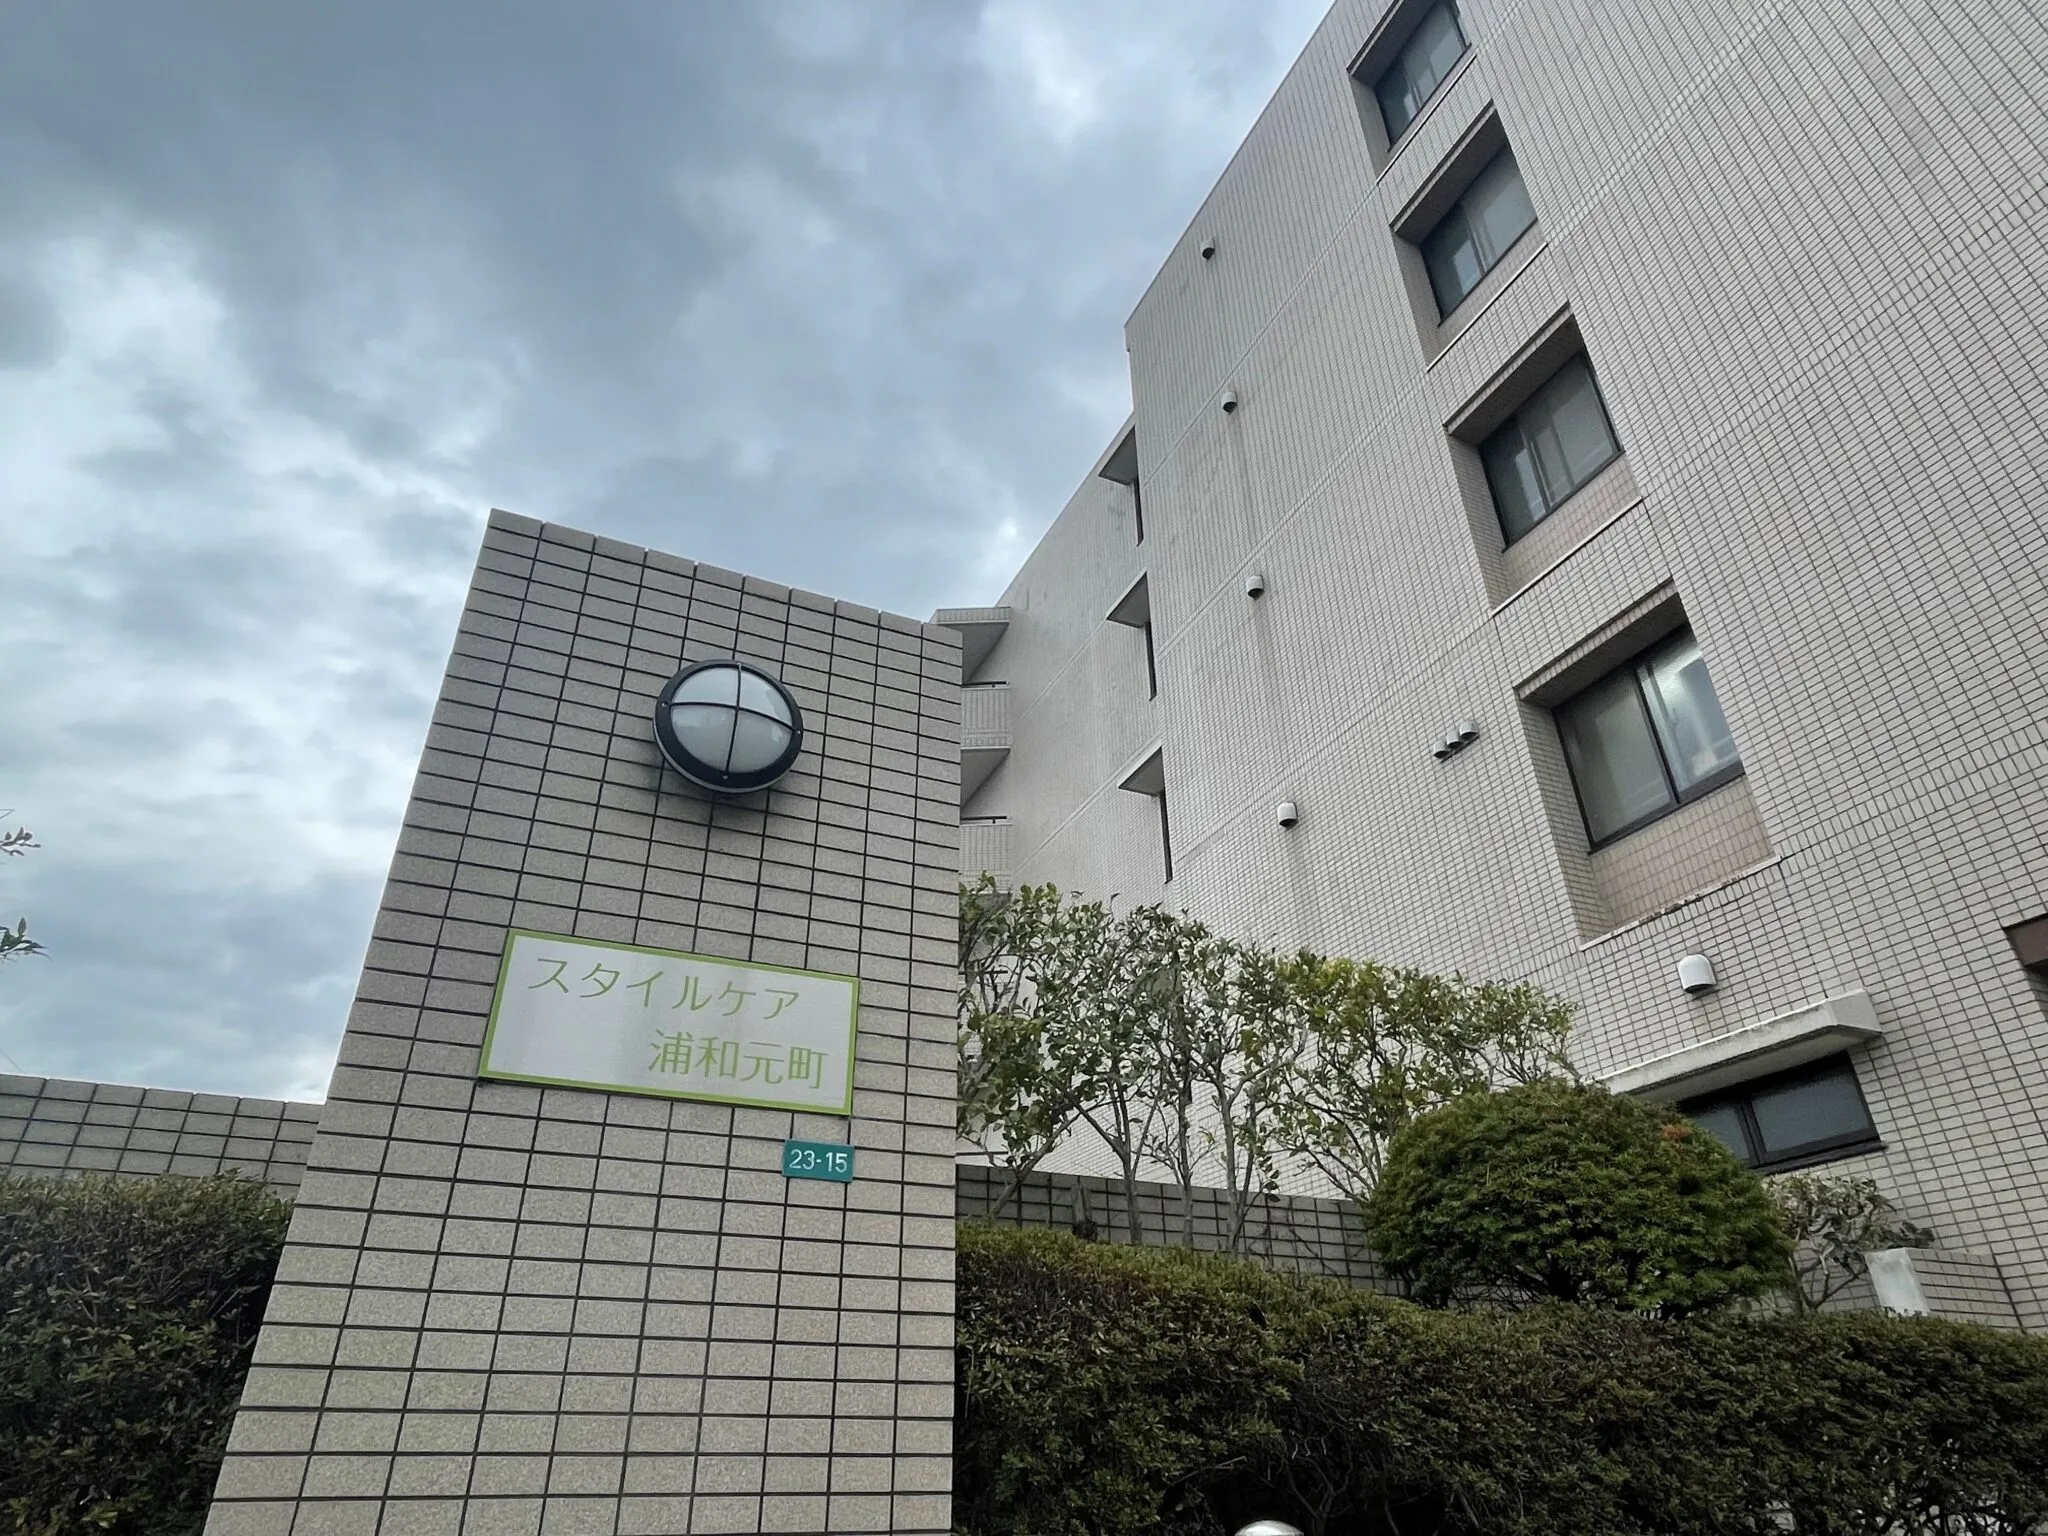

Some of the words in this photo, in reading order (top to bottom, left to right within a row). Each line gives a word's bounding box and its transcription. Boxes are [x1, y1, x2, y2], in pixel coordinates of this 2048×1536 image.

[528, 957, 800, 1020] スタイルケア
[648, 1029, 829, 1089] 浦和元町
[789, 1148, 848, 1173] 23-15
